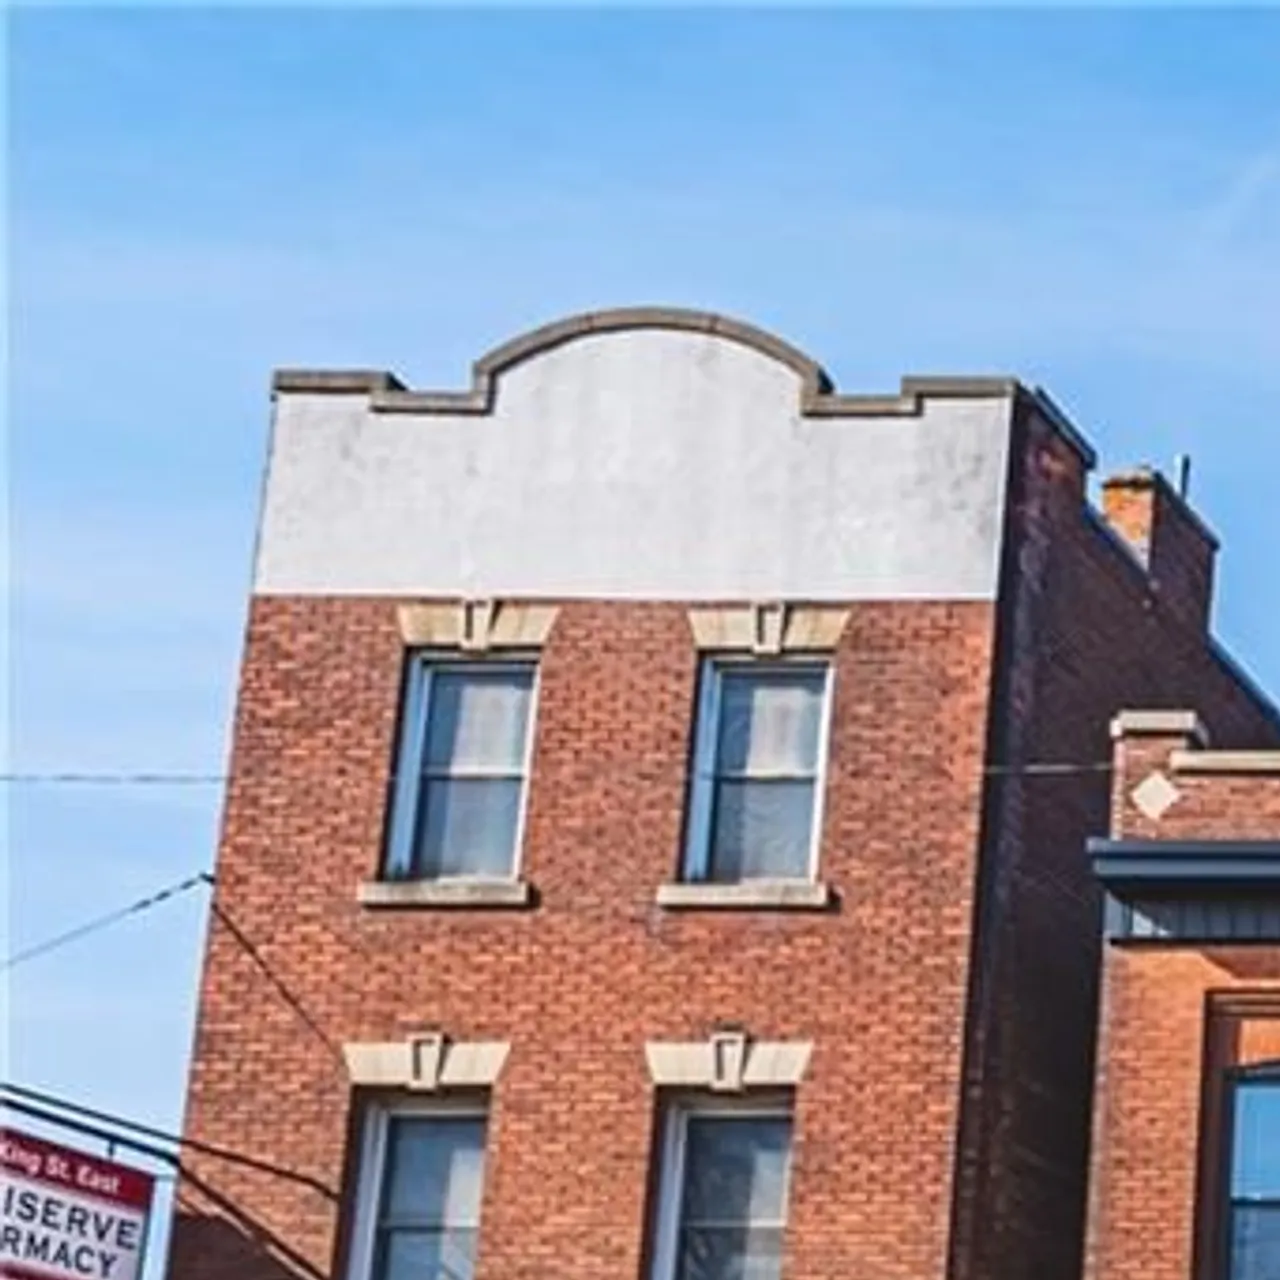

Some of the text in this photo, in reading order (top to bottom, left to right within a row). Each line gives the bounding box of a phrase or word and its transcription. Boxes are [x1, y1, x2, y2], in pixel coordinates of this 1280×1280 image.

[77, 1163, 119, 1196] East
[4, 1186, 138, 1251] ISERVE
[0, 1224, 118, 1279] RMACY
